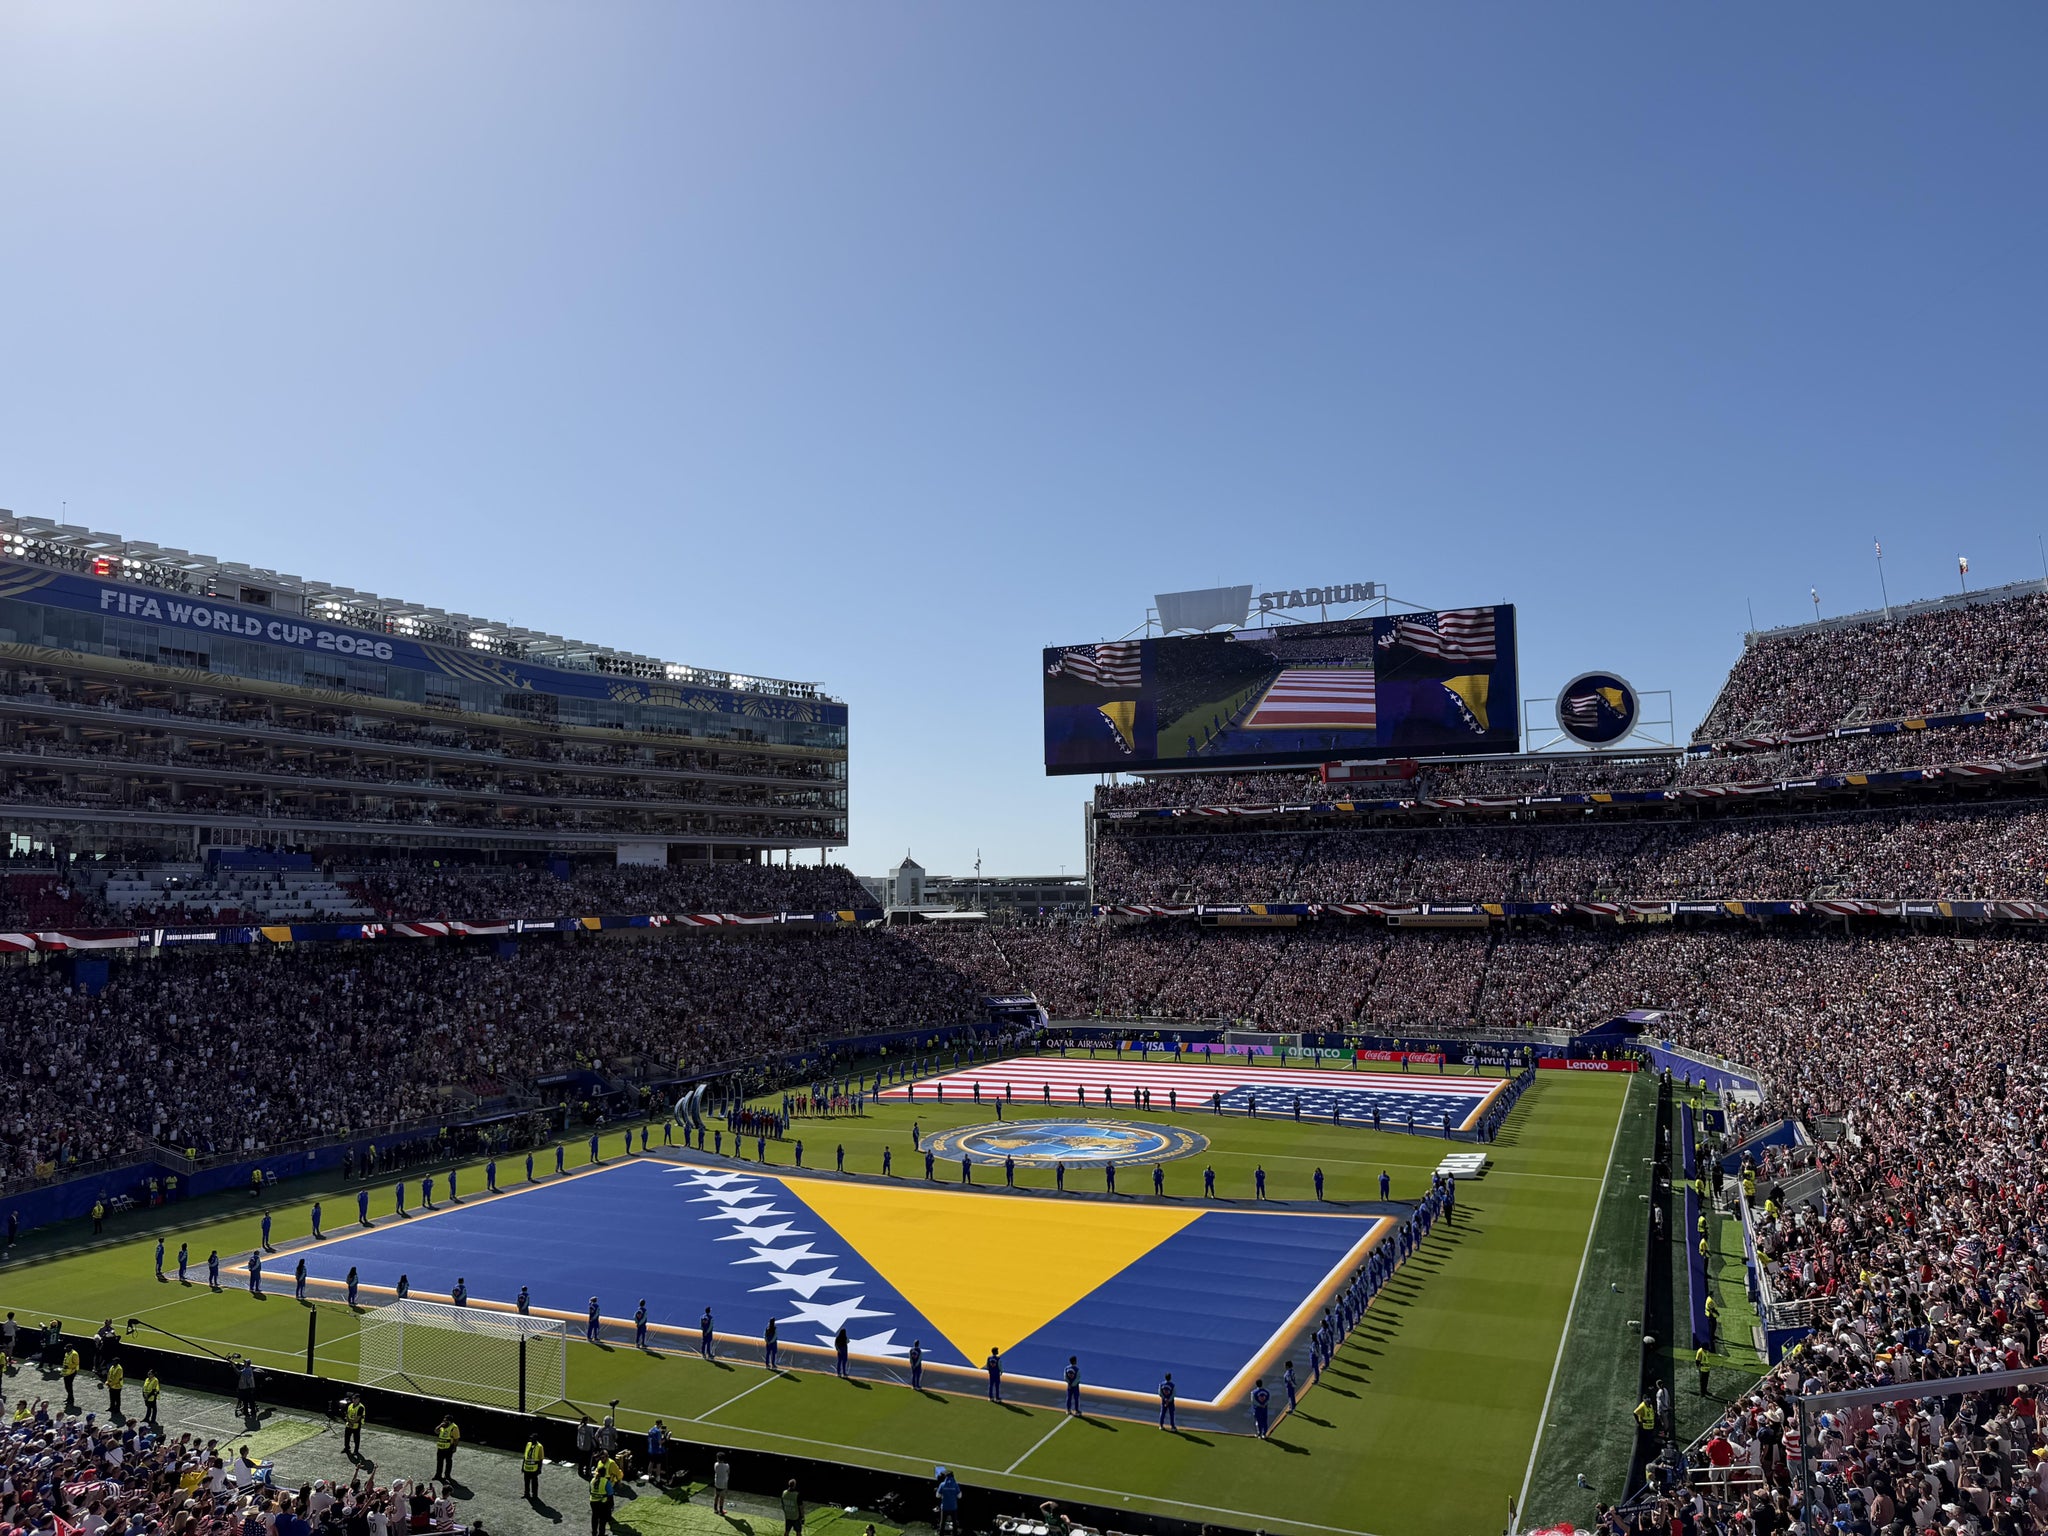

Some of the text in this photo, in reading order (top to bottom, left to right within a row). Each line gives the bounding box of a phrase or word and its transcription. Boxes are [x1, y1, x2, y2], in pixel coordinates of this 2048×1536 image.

[1258, 581, 1375, 612] STADIUM
[101, 589, 393, 660] FIFA WORLD CUP 2026
[1060, 901, 1086, 910] CITY of
[154, 929, 164, 946] V
[1046, 1039, 1075, 1048] QATAR
[1077, 1040, 1114, 1049] AIRWAYS
[1288, 1046, 1340, 1058] aramco
[1364, 1050, 1391, 1060] Coca-Cola
[1408, 1052, 1436, 1062] Coca-Cola
[1480, 1056, 1522, 1066] HYUNAI
[1566, 1059, 1609, 1071] Lenovo
